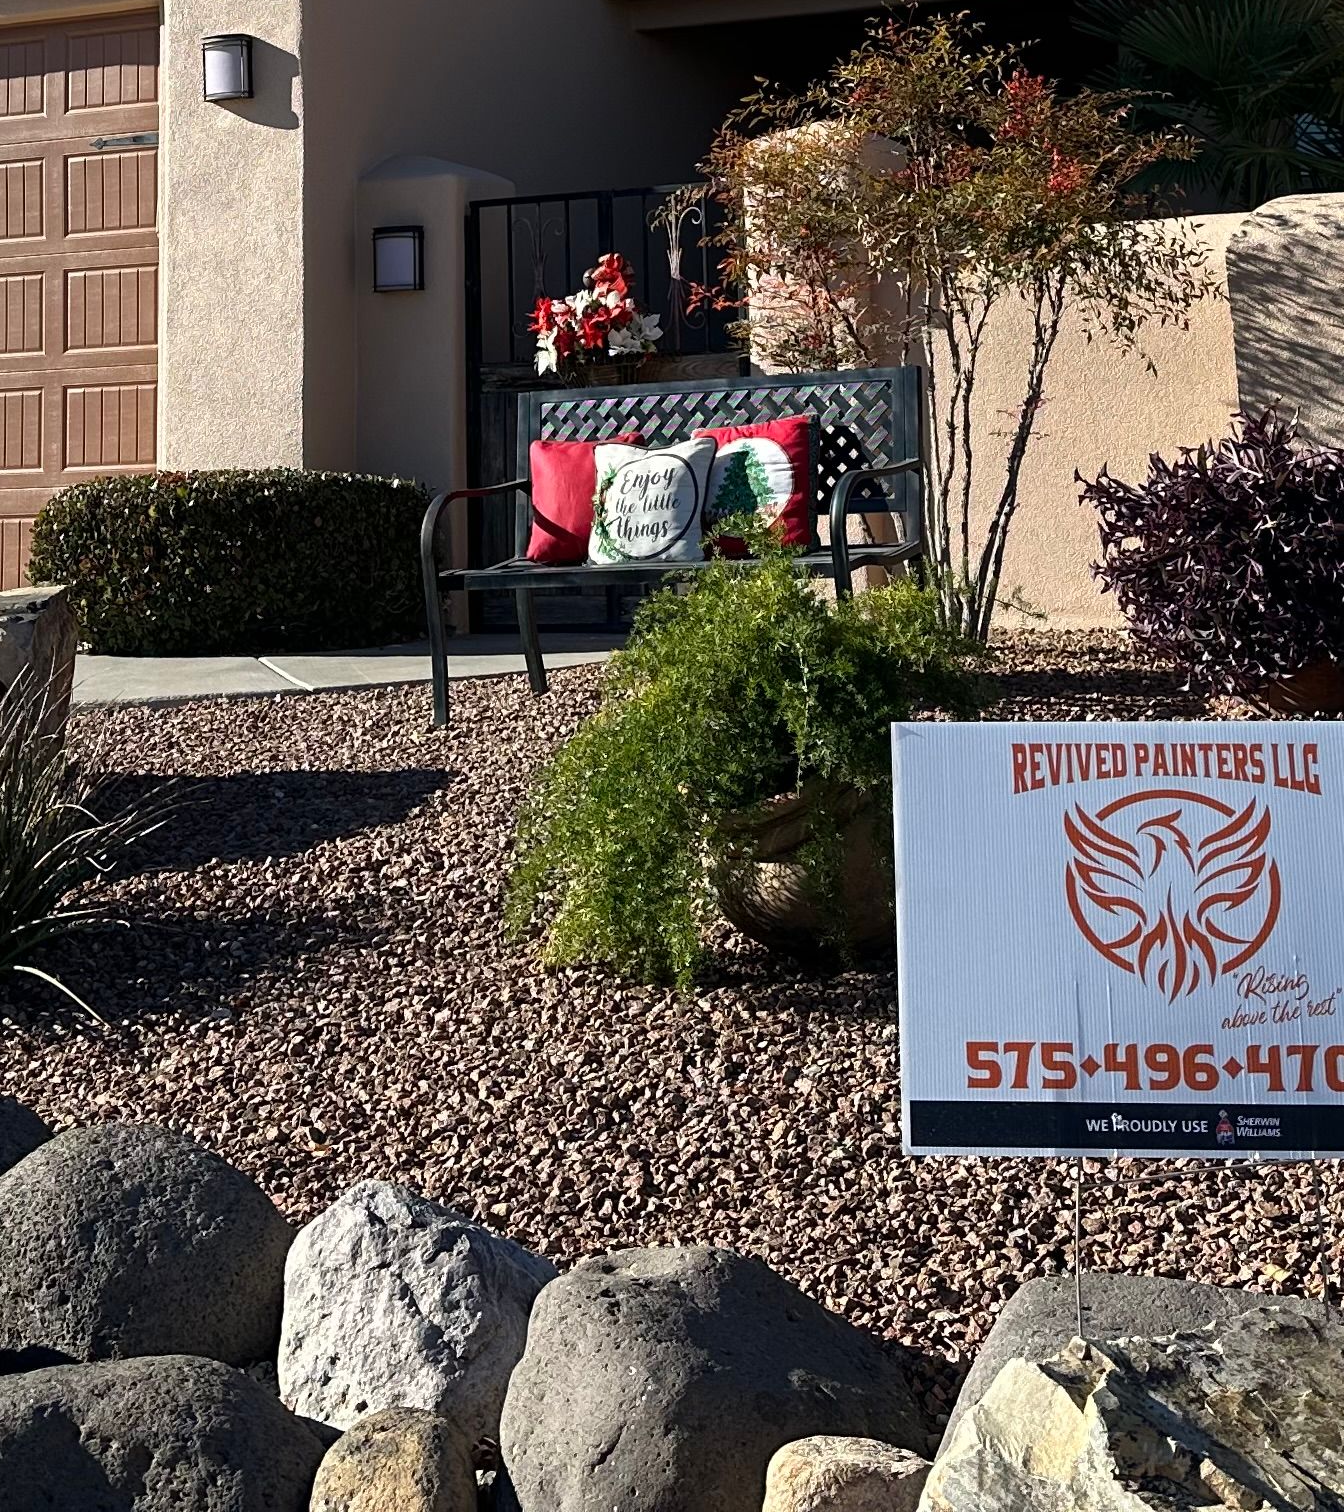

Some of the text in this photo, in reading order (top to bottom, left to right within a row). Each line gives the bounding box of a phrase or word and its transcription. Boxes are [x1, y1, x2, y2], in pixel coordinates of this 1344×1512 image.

[620, 467, 675, 500] Enjoy
[616, 493, 681, 516] the little
[609, 515, 670, 542] things
[1011, 743, 1323, 796] REVIVED PAINTERS LLC
[1221, 1003, 1268, 1030] above
[1271, 999, 1302, 1024] the
[1085, 1118, 1110, 1133] WE
[1181, 1120, 1209, 1134] USE
